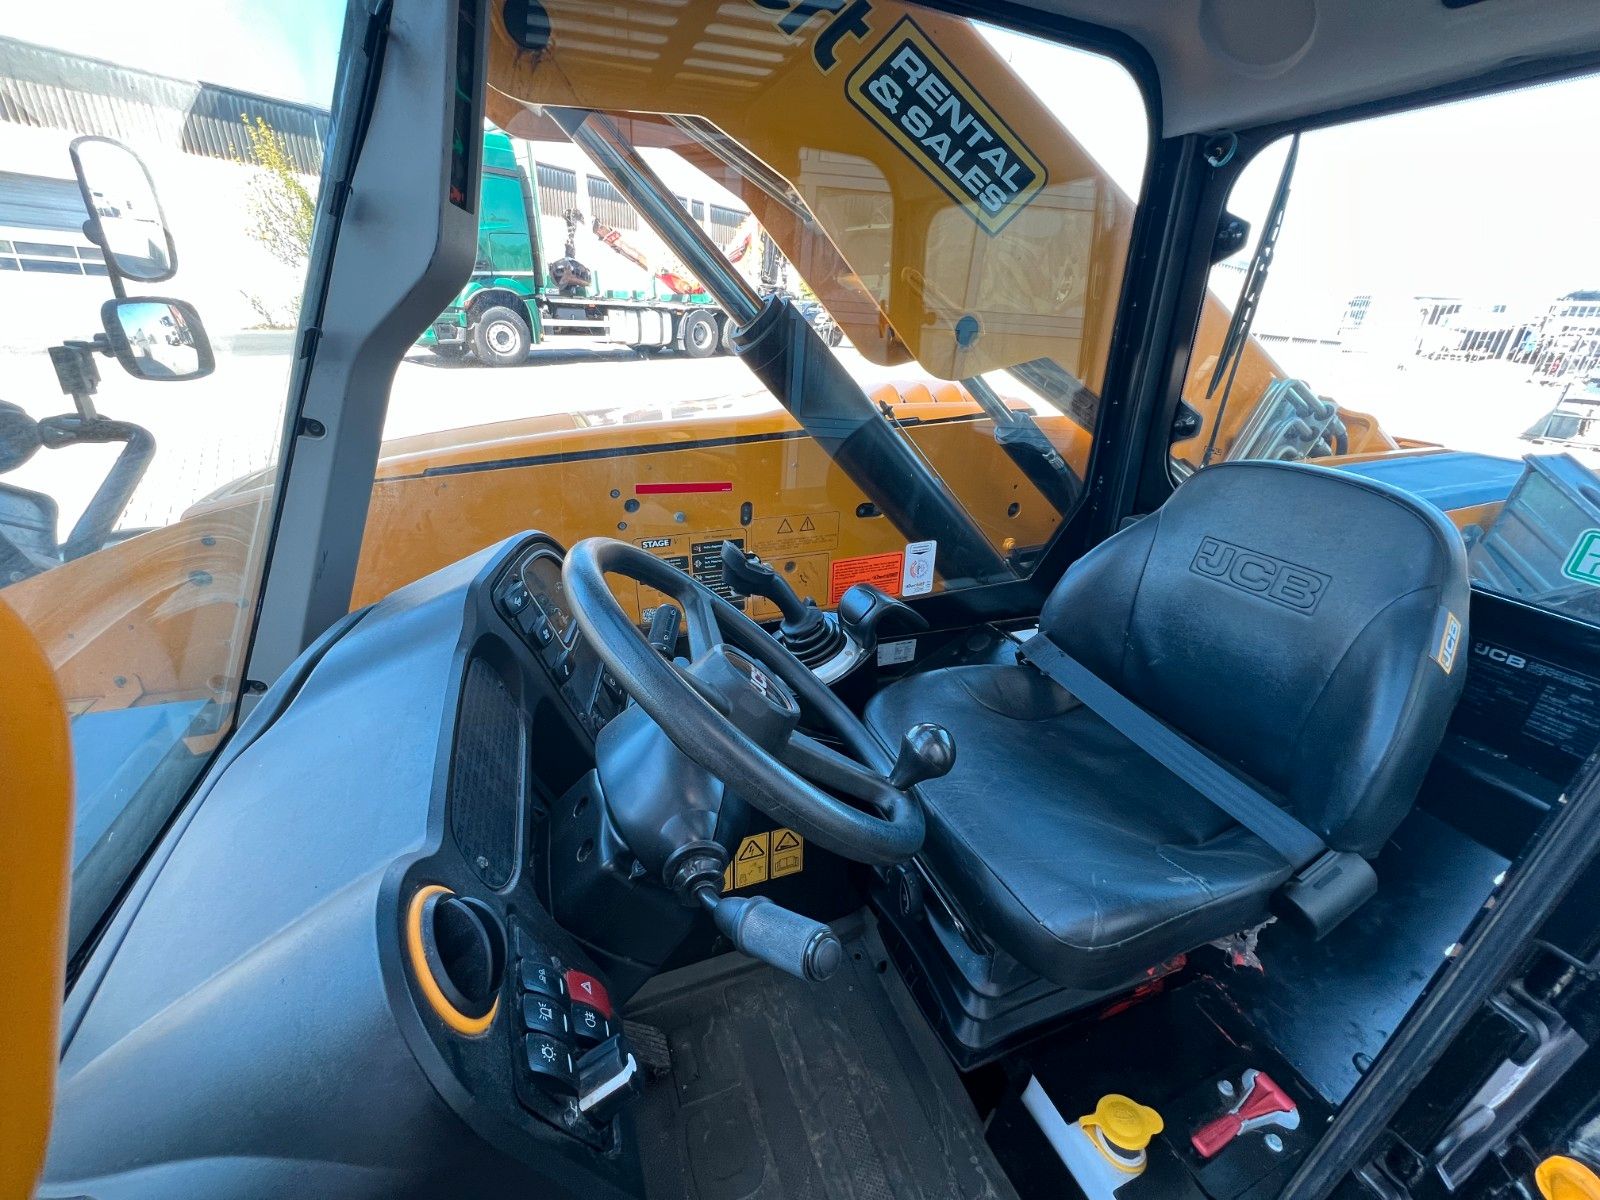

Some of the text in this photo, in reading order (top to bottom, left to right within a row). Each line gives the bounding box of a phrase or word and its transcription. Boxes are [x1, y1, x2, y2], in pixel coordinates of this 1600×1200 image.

[868, 75, 1008, 212] & SALES
[891, 47, 1019, 192] RENTAL
[642, 540, 670, 548] STAGE
[1196, 541, 1322, 609] JCB
[1441, 622, 1457, 666] JCB
[1474, 642, 1526, 669] JCB
